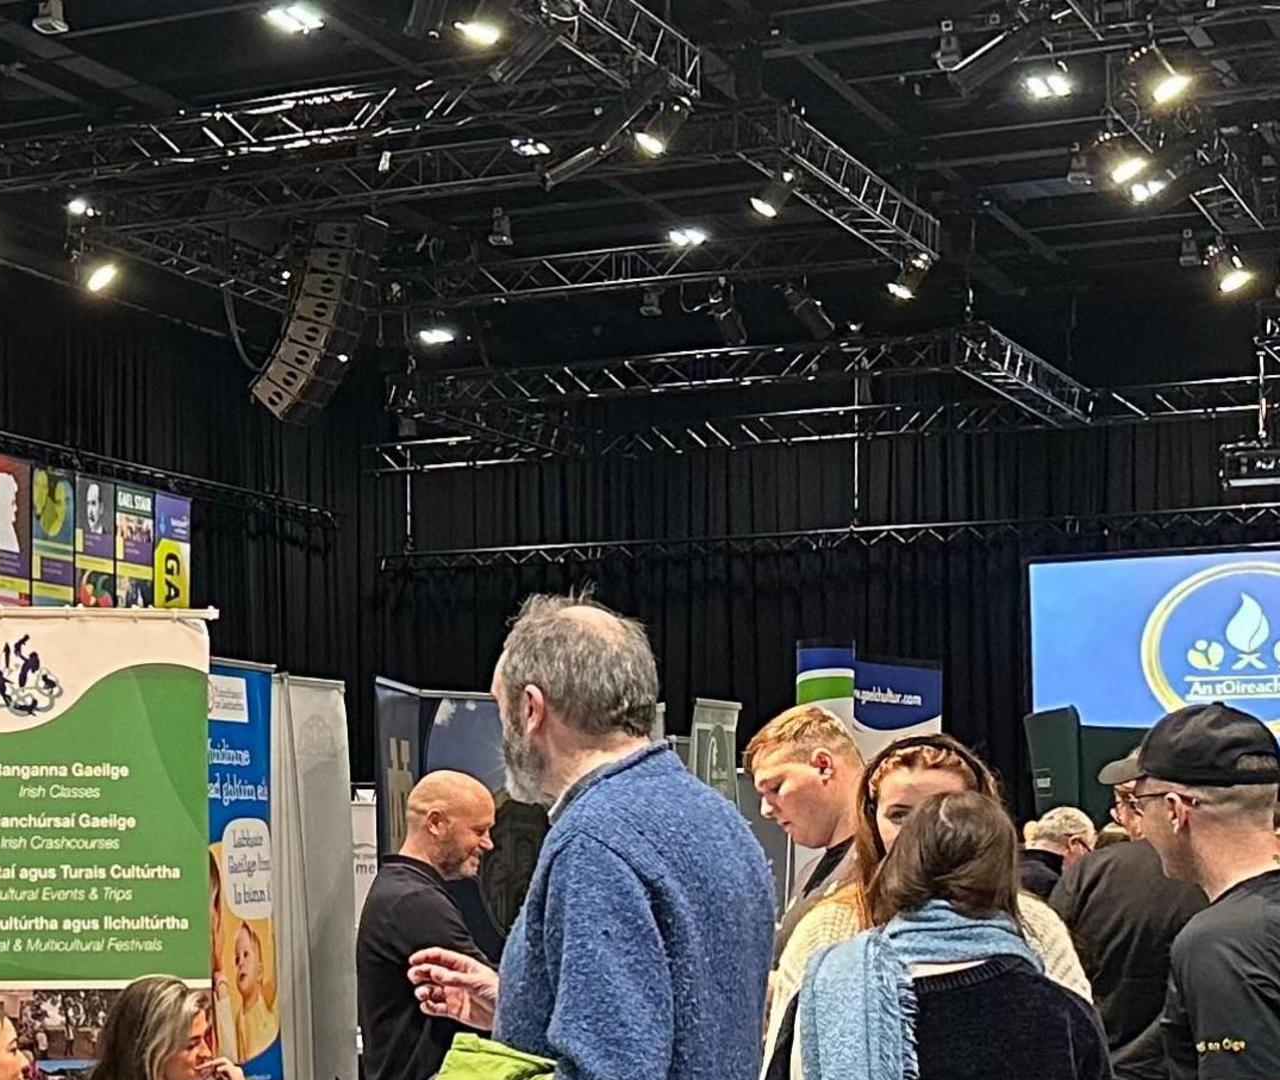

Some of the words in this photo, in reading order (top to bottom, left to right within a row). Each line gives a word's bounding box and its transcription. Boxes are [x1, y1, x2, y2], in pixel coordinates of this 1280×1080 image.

[1190, 681, 1213, 696] An
[71, 762, 130, 781] Gaeilge
[19, 784, 46, 798] Irish
[49, 785, 101, 799] Classes
[78, 813, 137, 832] Gaeilge
[0, 835, 27, 850] Irish
[29, 836, 120, 850] Crashcourses
[19, 868, 57, 883] agus
[59, 864, 107, 880] Turais
[109, 863, 181, 880] Cultúrtha
[41, 887, 86, 901] Events
[89, 887, 99, 901] &
[103, 886, 133, 904] Trips
[62, 918, 100, 934] agus
[103, 915, 190, 931] Ilchultúrtha
[13, 938, 22, 952] &
[26, 938, 105, 952] Multicultural
[107, 937, 163, 952] Festivals
